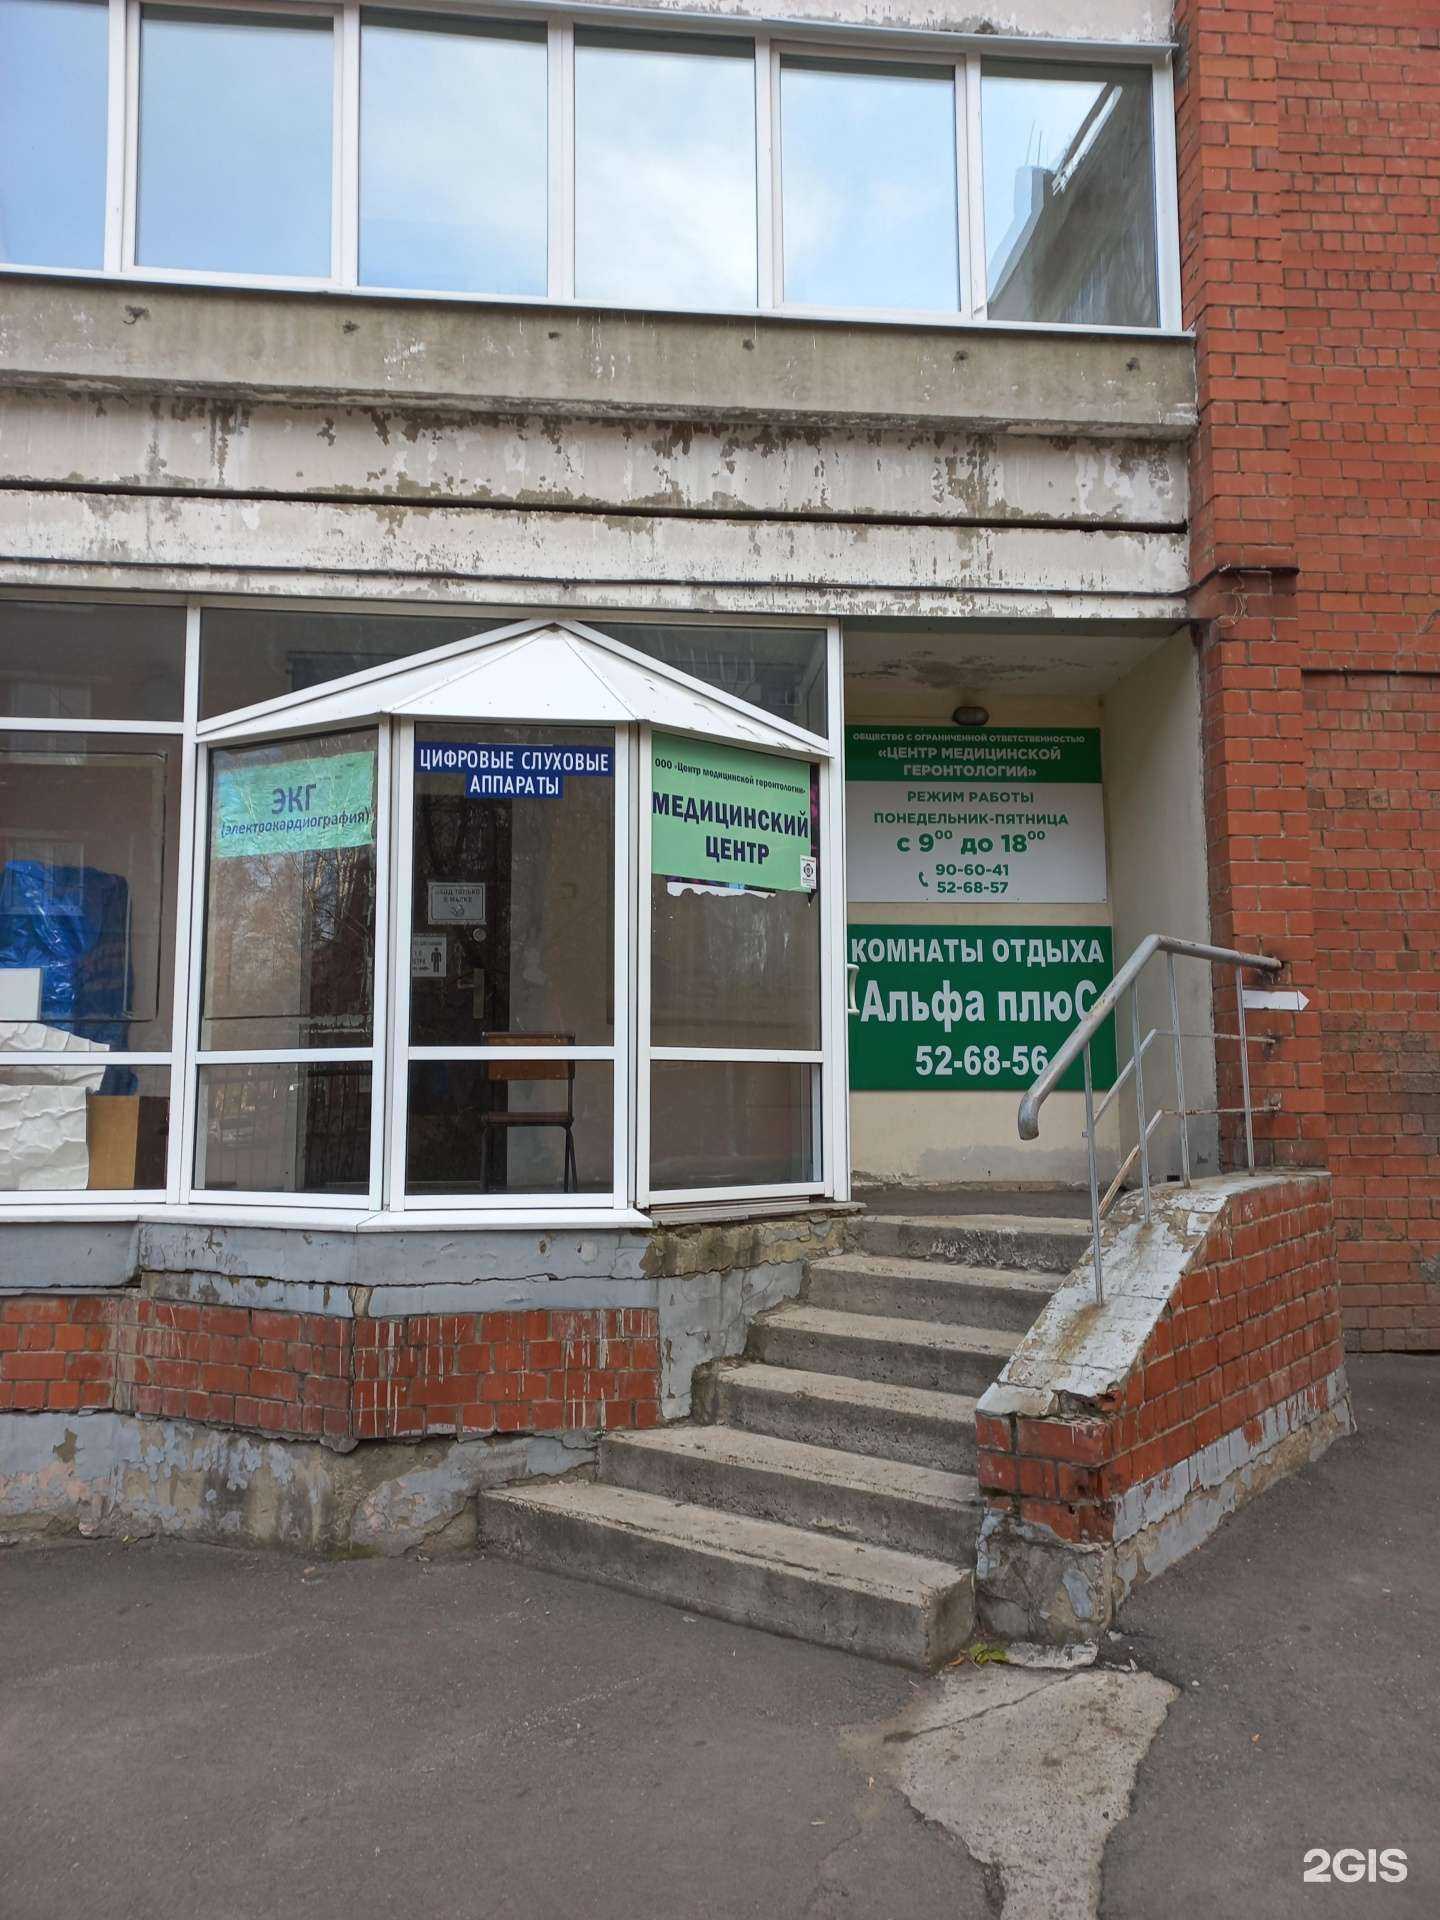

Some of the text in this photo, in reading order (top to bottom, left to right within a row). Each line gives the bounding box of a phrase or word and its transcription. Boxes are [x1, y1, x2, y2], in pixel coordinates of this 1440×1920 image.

[853, 733, 904, 741] ОБЩЕСТВО
[915, 732, 988, 742] ОГРАНИЧЕННОЙ
[989, 734, 1085, 743] ОТВЕТСТВЕННОСТЬЮ
[420, 749, 609, 771] ЦИФРОВЫЕ СЛУХОВЫЕ
[878, 746, 1061, 761] «ЦЕНТР МЕДИЦИНСКОЙ
[655, 758, 673, 769] ООО
[703, 768, 754, 785] медицинской
[903, 764, 1037, 777] ГЕРОНТОЛОГИИ»
[470, 775, 559, 795] АППАРАТЫ
[271, 783, 316, 815] ЭКГ
[907, 791, 1034, 803] РЕЖИМ РАБОТЫ
[652, 791, 809, 838] МЕДИЦИНСКИЙ
[874, 812, 1069, 826] ПОНЕДЕЛЬНИК-ПЯТНИЦА
[705, 836, 770, 864] ЦЕНТР
[960, 837, 993, 855] до
[935, 864, 1009, 876] 90-60-41
[937, 882, 1008, 894] 52-68-57
[851, 938, 1104, 967] КОМНАТЫ ОТДЫХА
[860, 980, 1097, 1032] Альфа плюС
[916, 1045, 1049, 1075] 52-68-56
